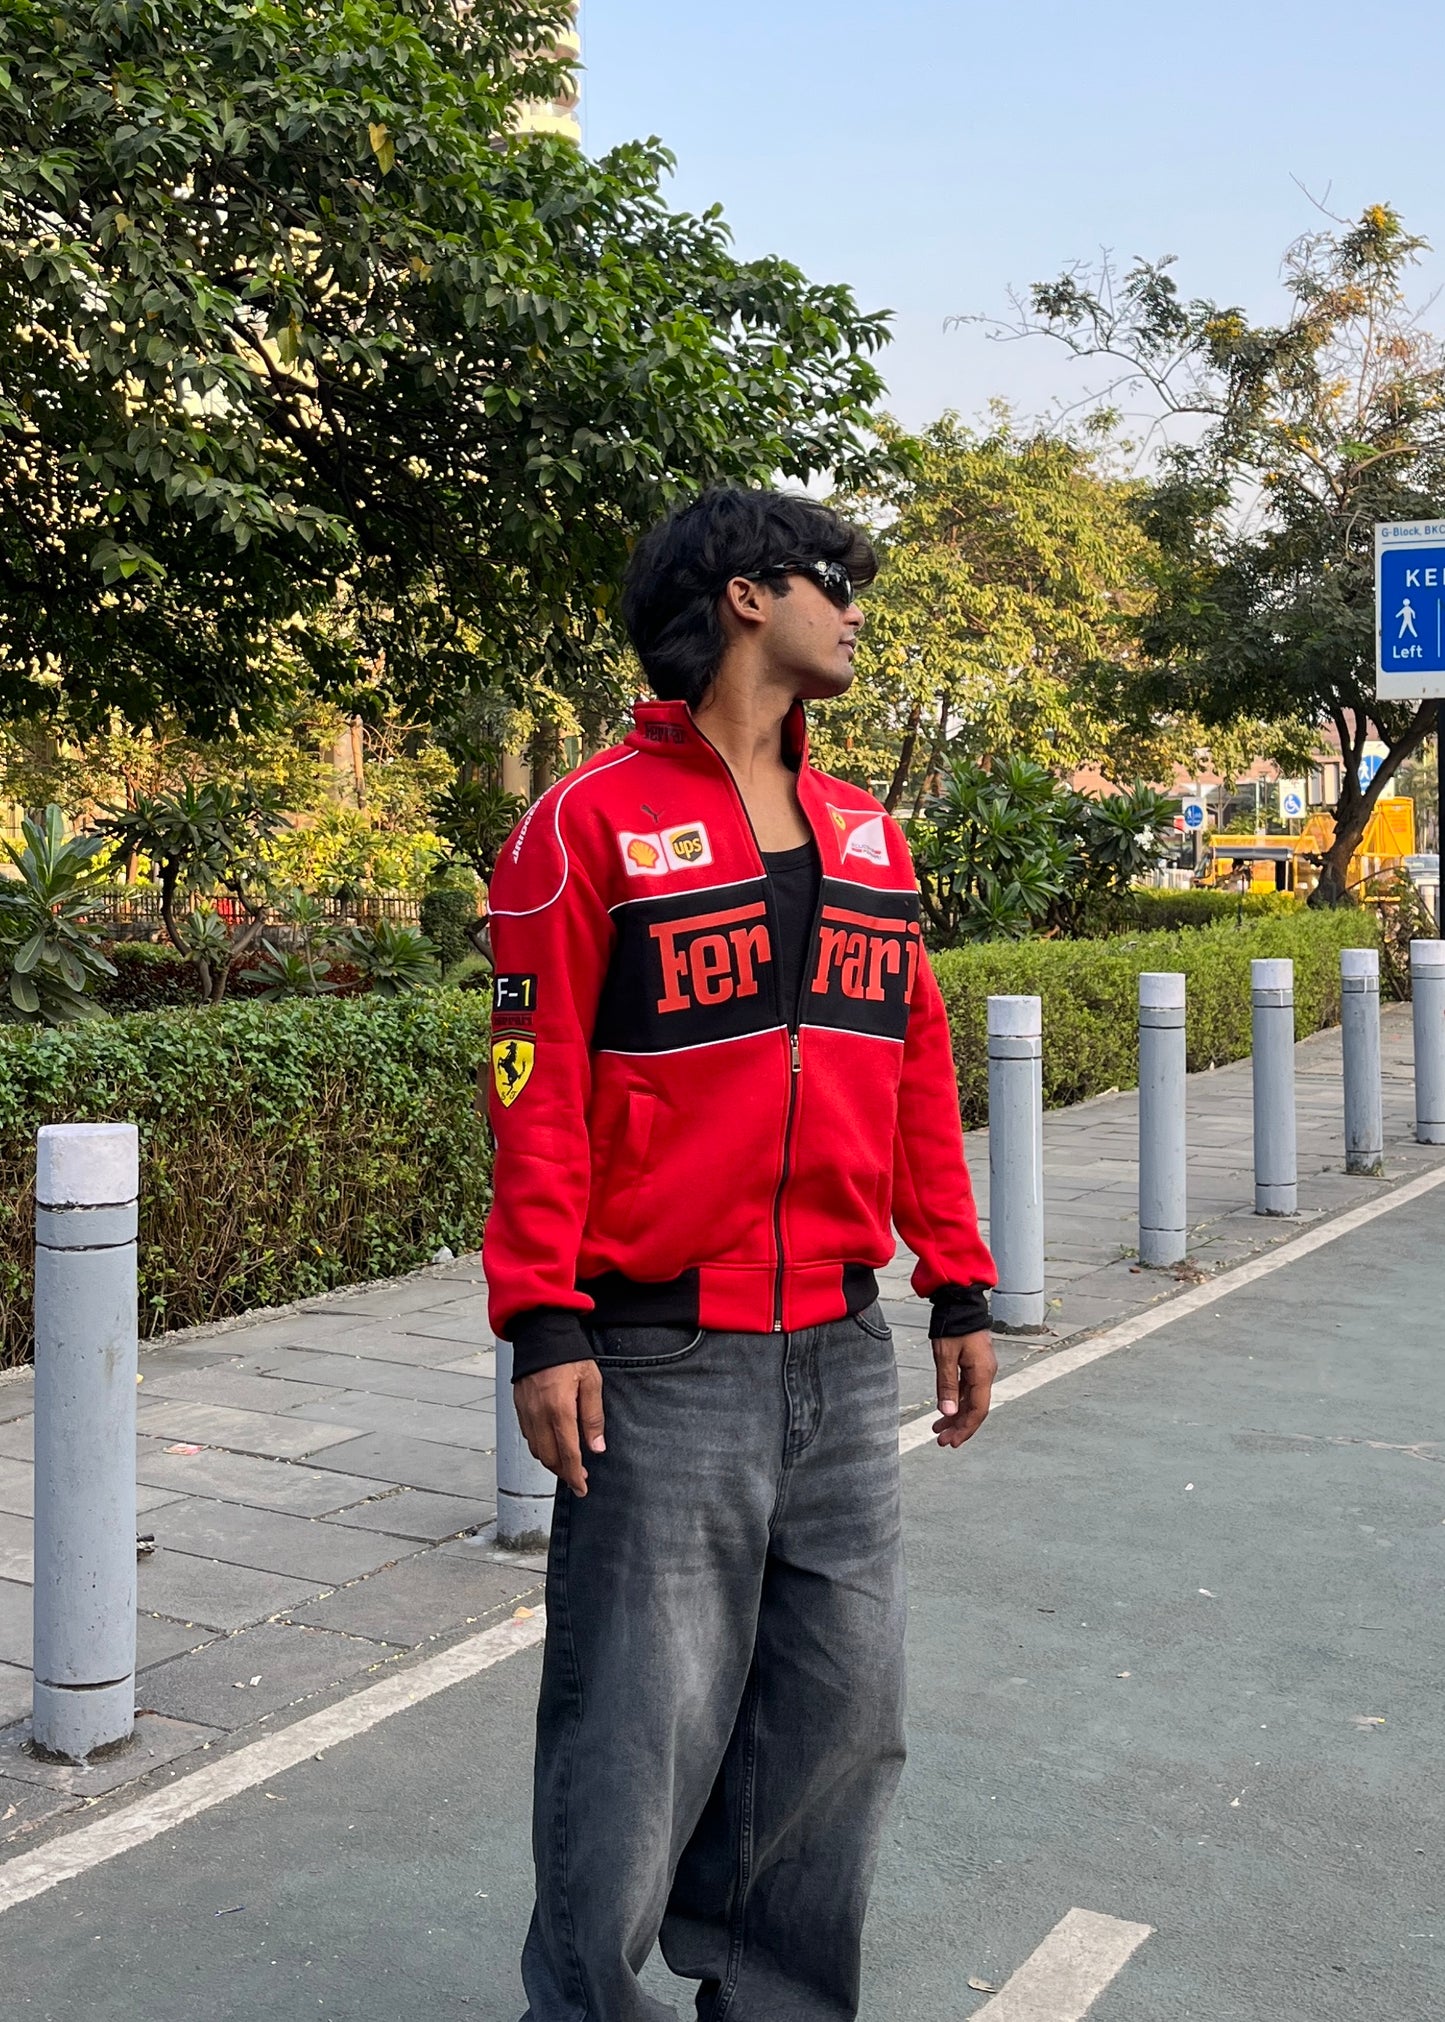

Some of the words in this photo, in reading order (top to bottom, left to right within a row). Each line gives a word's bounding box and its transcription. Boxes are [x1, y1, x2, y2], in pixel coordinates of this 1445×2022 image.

[1381, 526, 1422, 538] G-Block,
[1405, 567, 1445, 587] KE
[1392, 644, 1423, 659] Left
[673, 838, 702, 859] ups
[496, 978, 531, 1008] F-1
